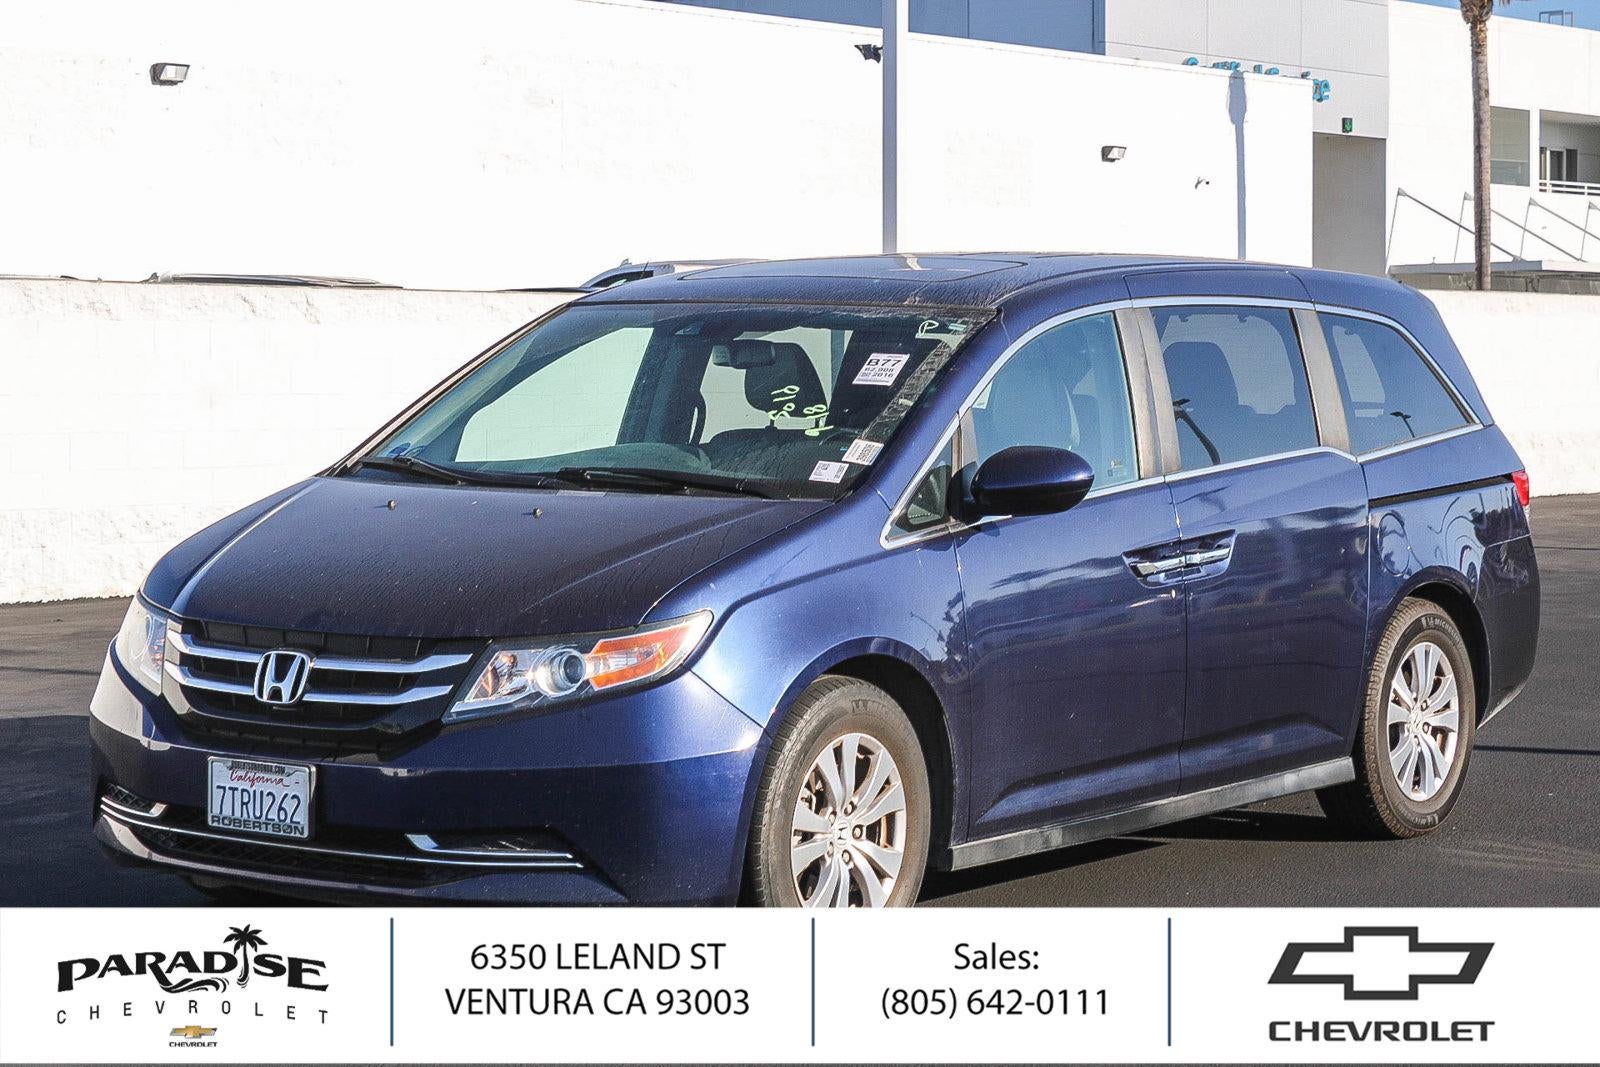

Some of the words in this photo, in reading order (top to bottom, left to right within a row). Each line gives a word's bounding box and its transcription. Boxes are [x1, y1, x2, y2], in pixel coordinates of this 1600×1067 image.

[867, 358, 902, 368] B77
[229, 768, 290, 788] California
[216, 784, 302, 826] 7TRU262
